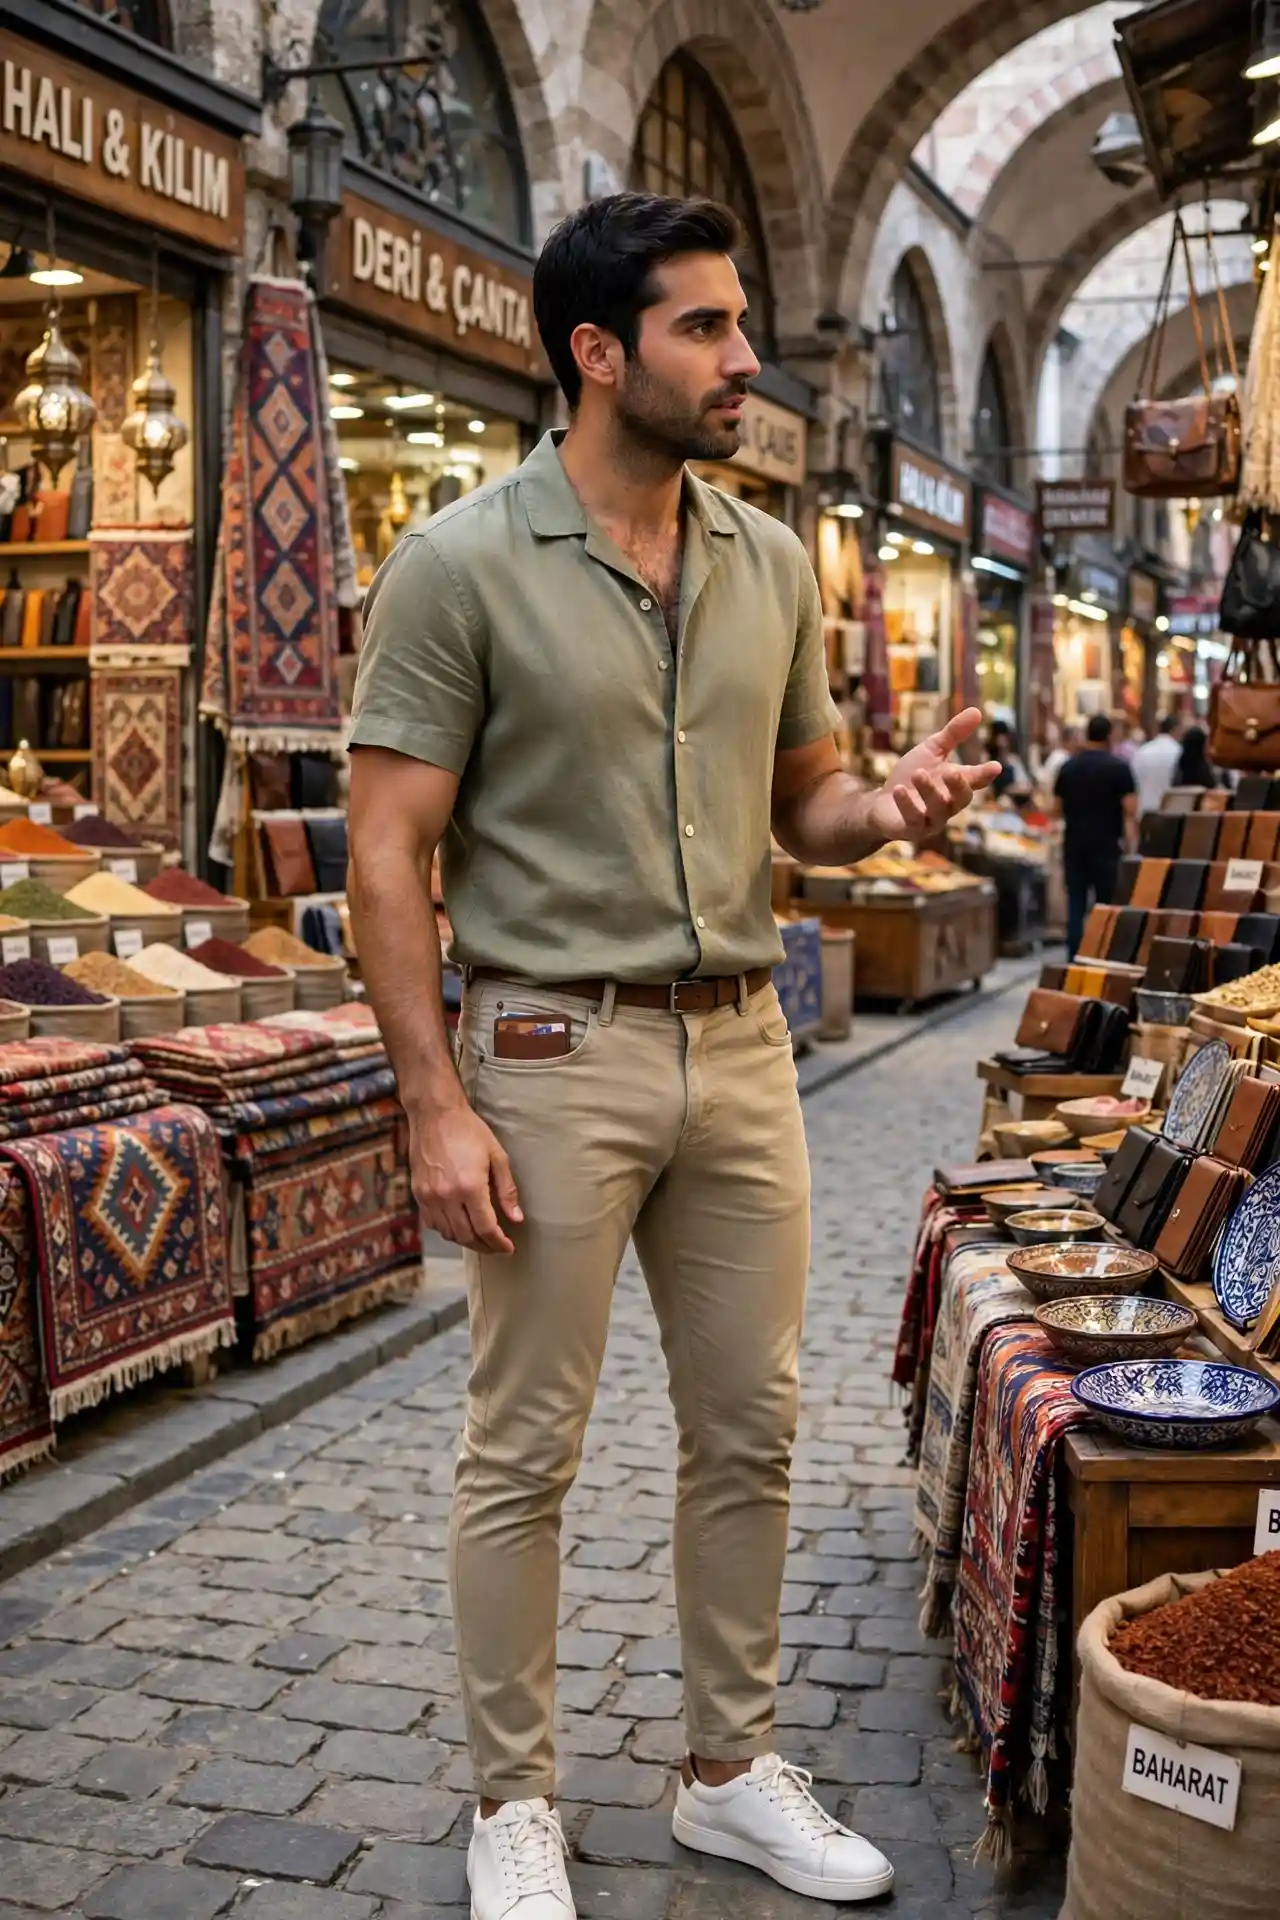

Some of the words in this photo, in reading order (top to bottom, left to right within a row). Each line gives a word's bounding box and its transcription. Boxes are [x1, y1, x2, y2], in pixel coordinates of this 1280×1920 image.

[4, 59, 93, 163] HALI
[103, 108, 131, 177] &
[353, 217, 422, 303] DERİ
[426, 253, 448, 314] &
[452, 265, 532, 349] ÇANTA
[1132, 1747, 1229, 1805] BAHARAT
